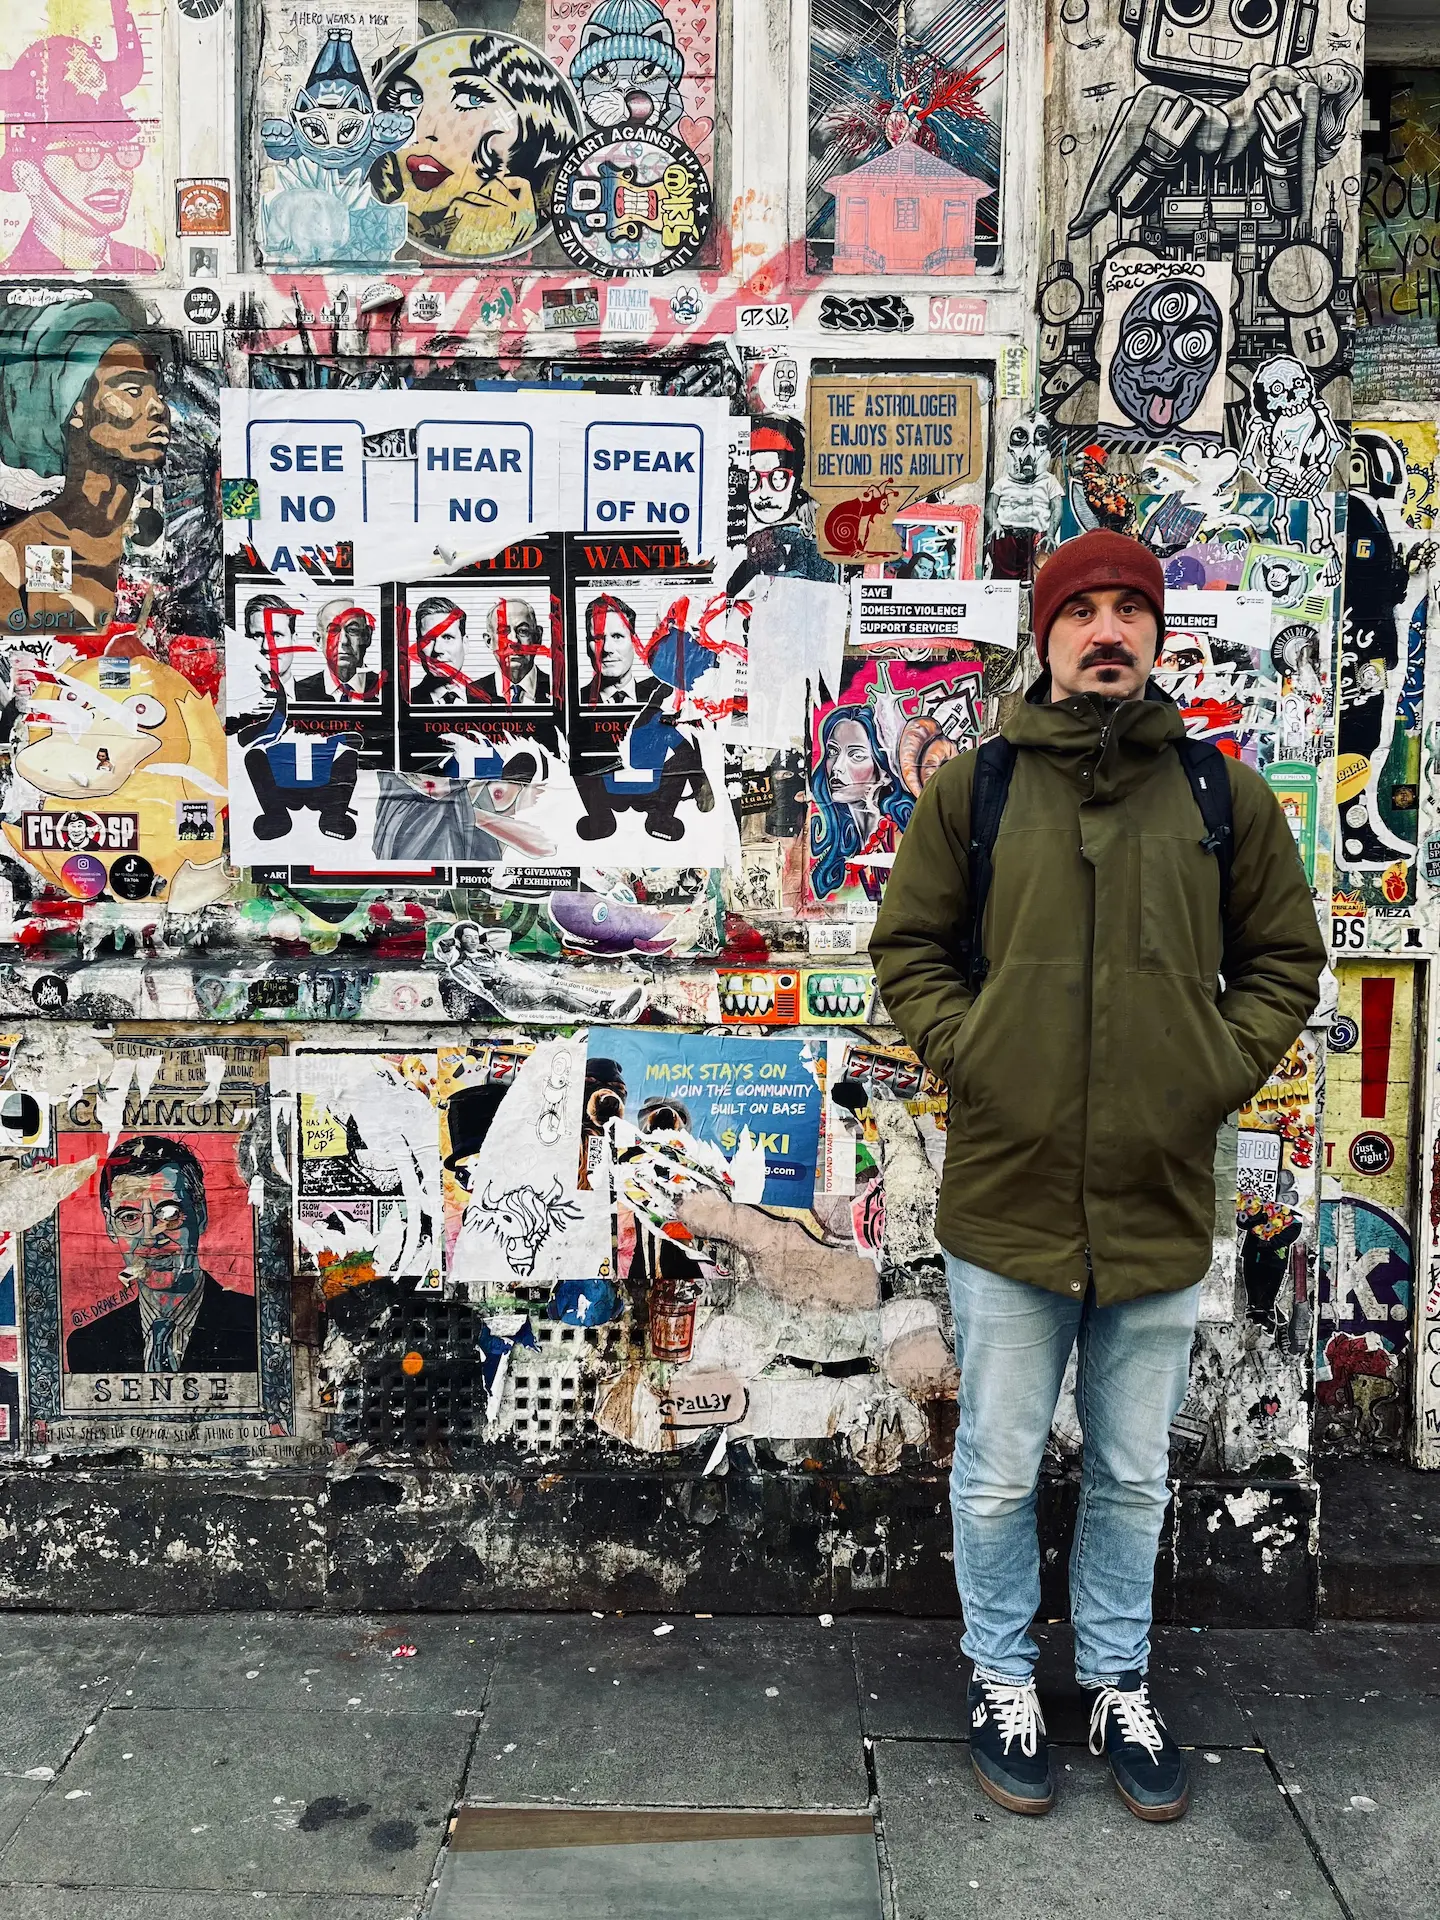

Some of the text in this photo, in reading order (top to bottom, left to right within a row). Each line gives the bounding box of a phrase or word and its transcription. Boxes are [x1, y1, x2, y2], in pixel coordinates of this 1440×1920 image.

[299, 11, 322, 26] HERO
[326, 13, 355, 25] WEARS
[611, 126, 681, 154] AGAINST
[3, 219, 20, 227] Pop
[930, 299, 984, 332] Skam
[827, 394, 958, 417] THE ASTROLOGER
[830, 424, 953, 447] ENJOYS STATUS
[269, 444, 344, 472] SEE
[427, 447, 522, 473] HEAR
[593, 450, 695, 473] SPEAK
[817, 453, 966, 476] BEYOND HIS ABILITY
[280, 495, 336, 523] NO
[450, 498, 498, 523] NO
[596, 500, 690, 524] OF NO
[861, 587, 888, 599] SAVE
[860, 605, 965, 617] DOMESTIC VIOLENCE
[860, 622, 958, 634] SUPPORT SERVICES
[1165, 616, 1216, 628] VIOLENCE
[288, 719, 352, 731] ENOCIDE
[425, 721, 536, 733] FOR GENOCIDE &
[594, 722, 622, 734] FOR
[27, 815, 135, 848] FC SP
[269, 871, 286, 880] ART
[524, 868, 572, 877] GIVEAWAYS
[524, 877, 572, 887] EXHIBITION
[1375, 908, 1411, 918] MEZA
[1331, 918, 1365, 949] BS
[645, 1062, 787, 1081] MASK STAYS ON
[671, 1083, 814, 1099] JOIN THE COMMUNITY
[711, 1102, 806, 1116] BUILT ON BASE
[305, 1117, 330, 1127] HAS A
[306, 1127, 336, 1147] PASTE
[313, 1140, 328, 1152] UP
[1254, 1140, 1279, 1160] BIG
[1355, 1143, 1374, 1156] just
[301, 1202, 320, 1210] SLOW
[93, 1377, 230, 1402] SENSE
[129, 1424, 169, 1441] COMMON
[174, 1425, 202, 1442] SENSE
[205, 1425, 235, 1443] THING
[237, 1425, 250, 1440] TO
